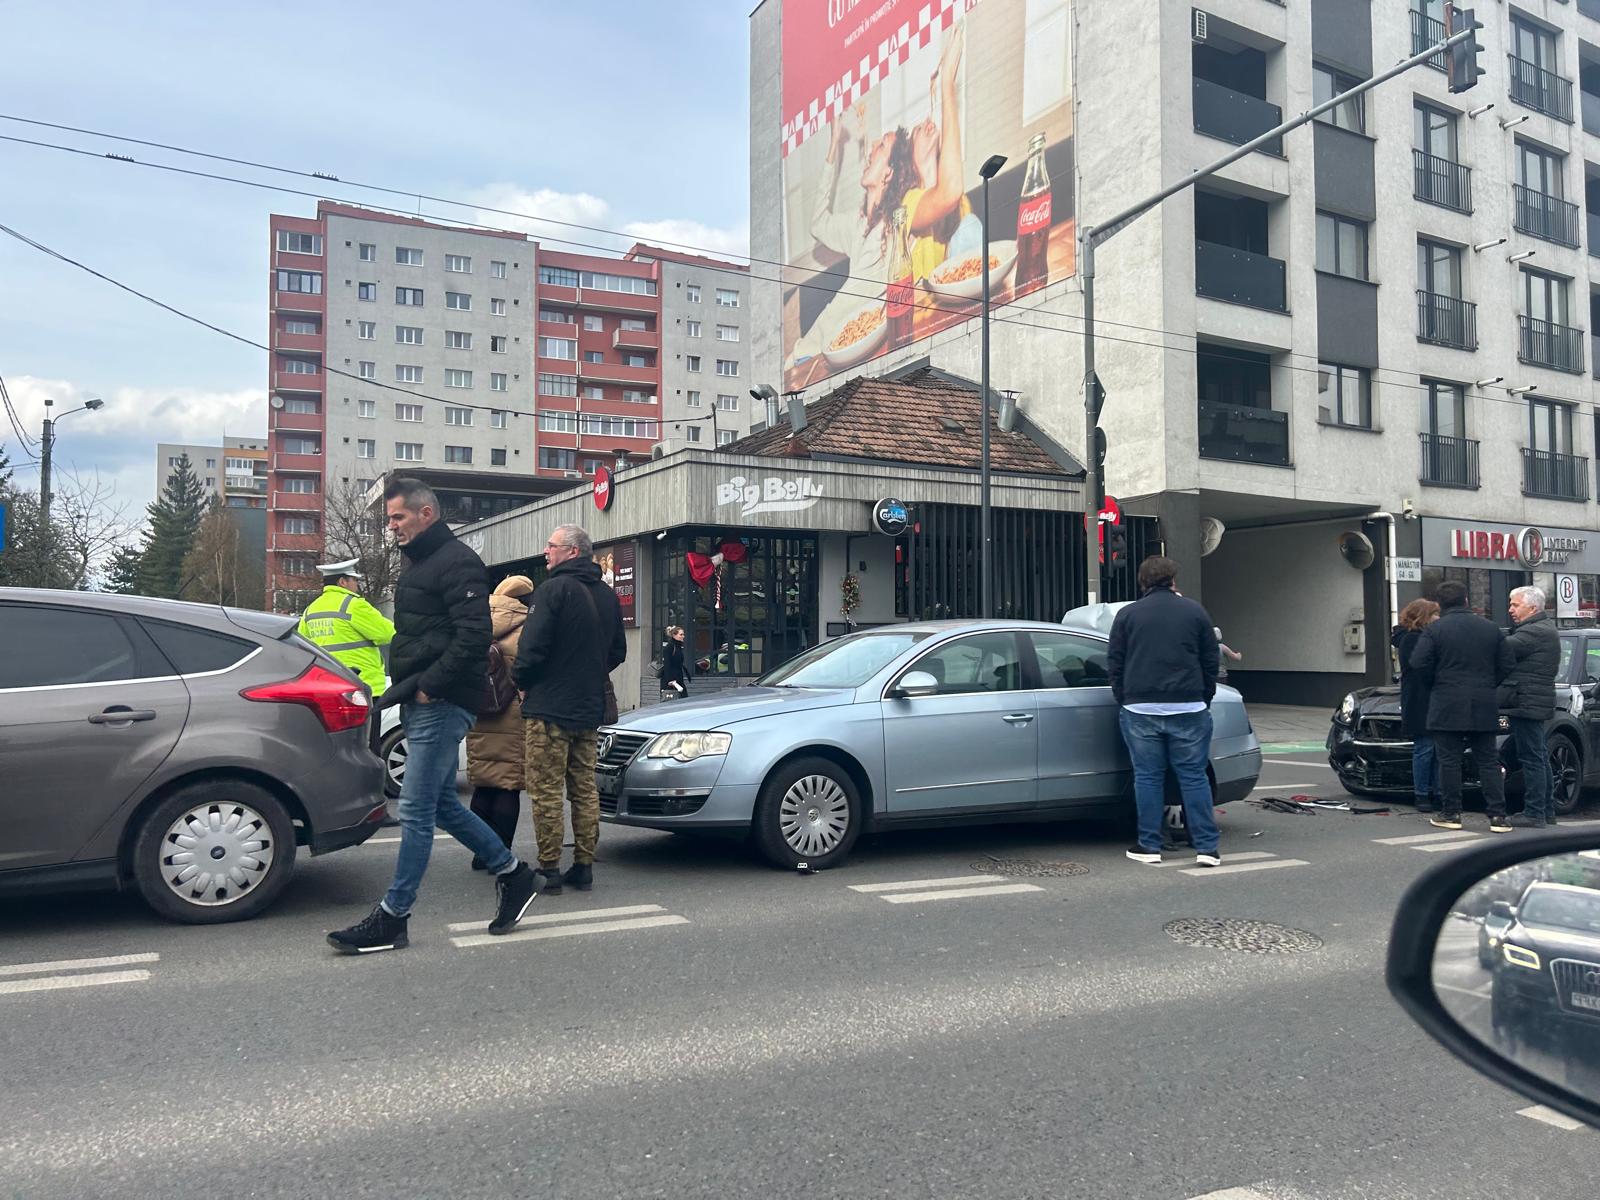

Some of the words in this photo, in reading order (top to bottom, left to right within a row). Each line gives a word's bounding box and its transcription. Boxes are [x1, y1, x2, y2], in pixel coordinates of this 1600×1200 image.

[717, 476, 760, 511] Big
[760, 476, 824, 512] Belly
[1452, 529, 1519, 560] LIBRA
[1544, 536, 1587, 551] INTERNET
[1544, 551, 1570, 563] BANK
